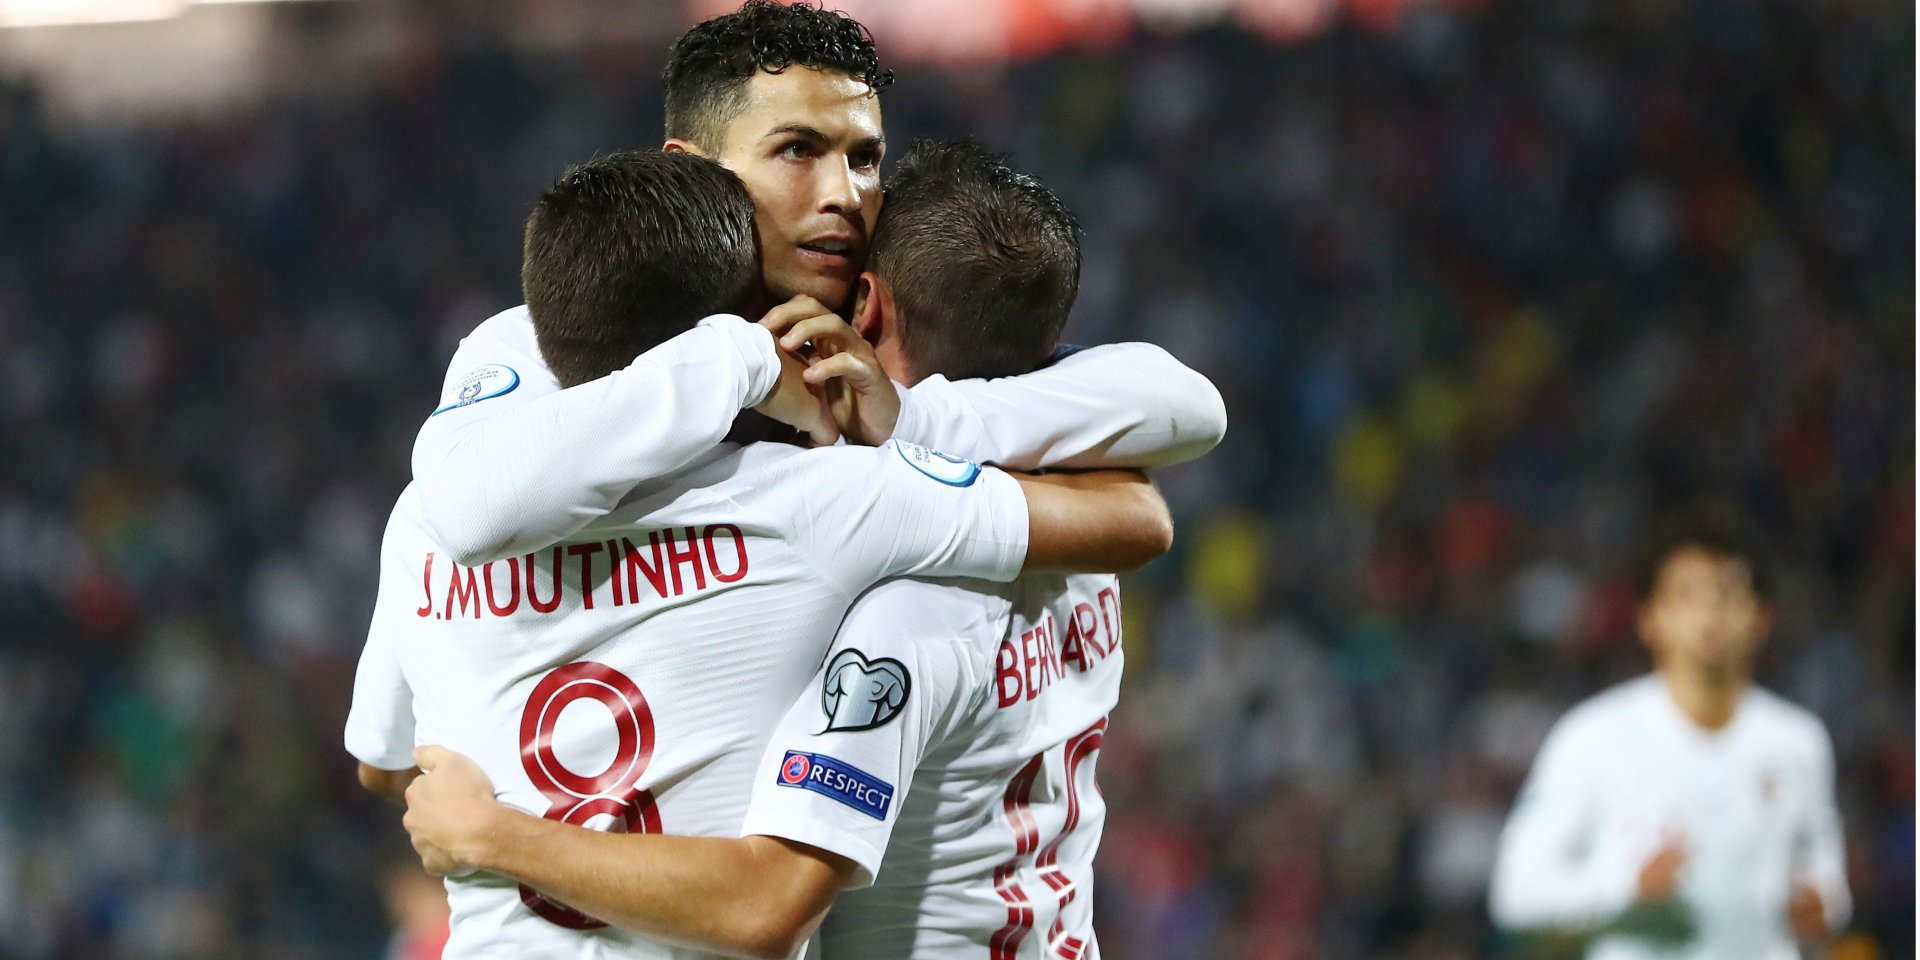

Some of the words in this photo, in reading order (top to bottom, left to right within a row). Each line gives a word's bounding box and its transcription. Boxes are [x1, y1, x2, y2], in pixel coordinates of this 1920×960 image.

[416, 523, 750, 621] J.MOUTINHO
[996, 582, 1120, 709] BERNARD
[519, 661, 663, 931] 8
[809, 764, 890, 810] RESPECT
